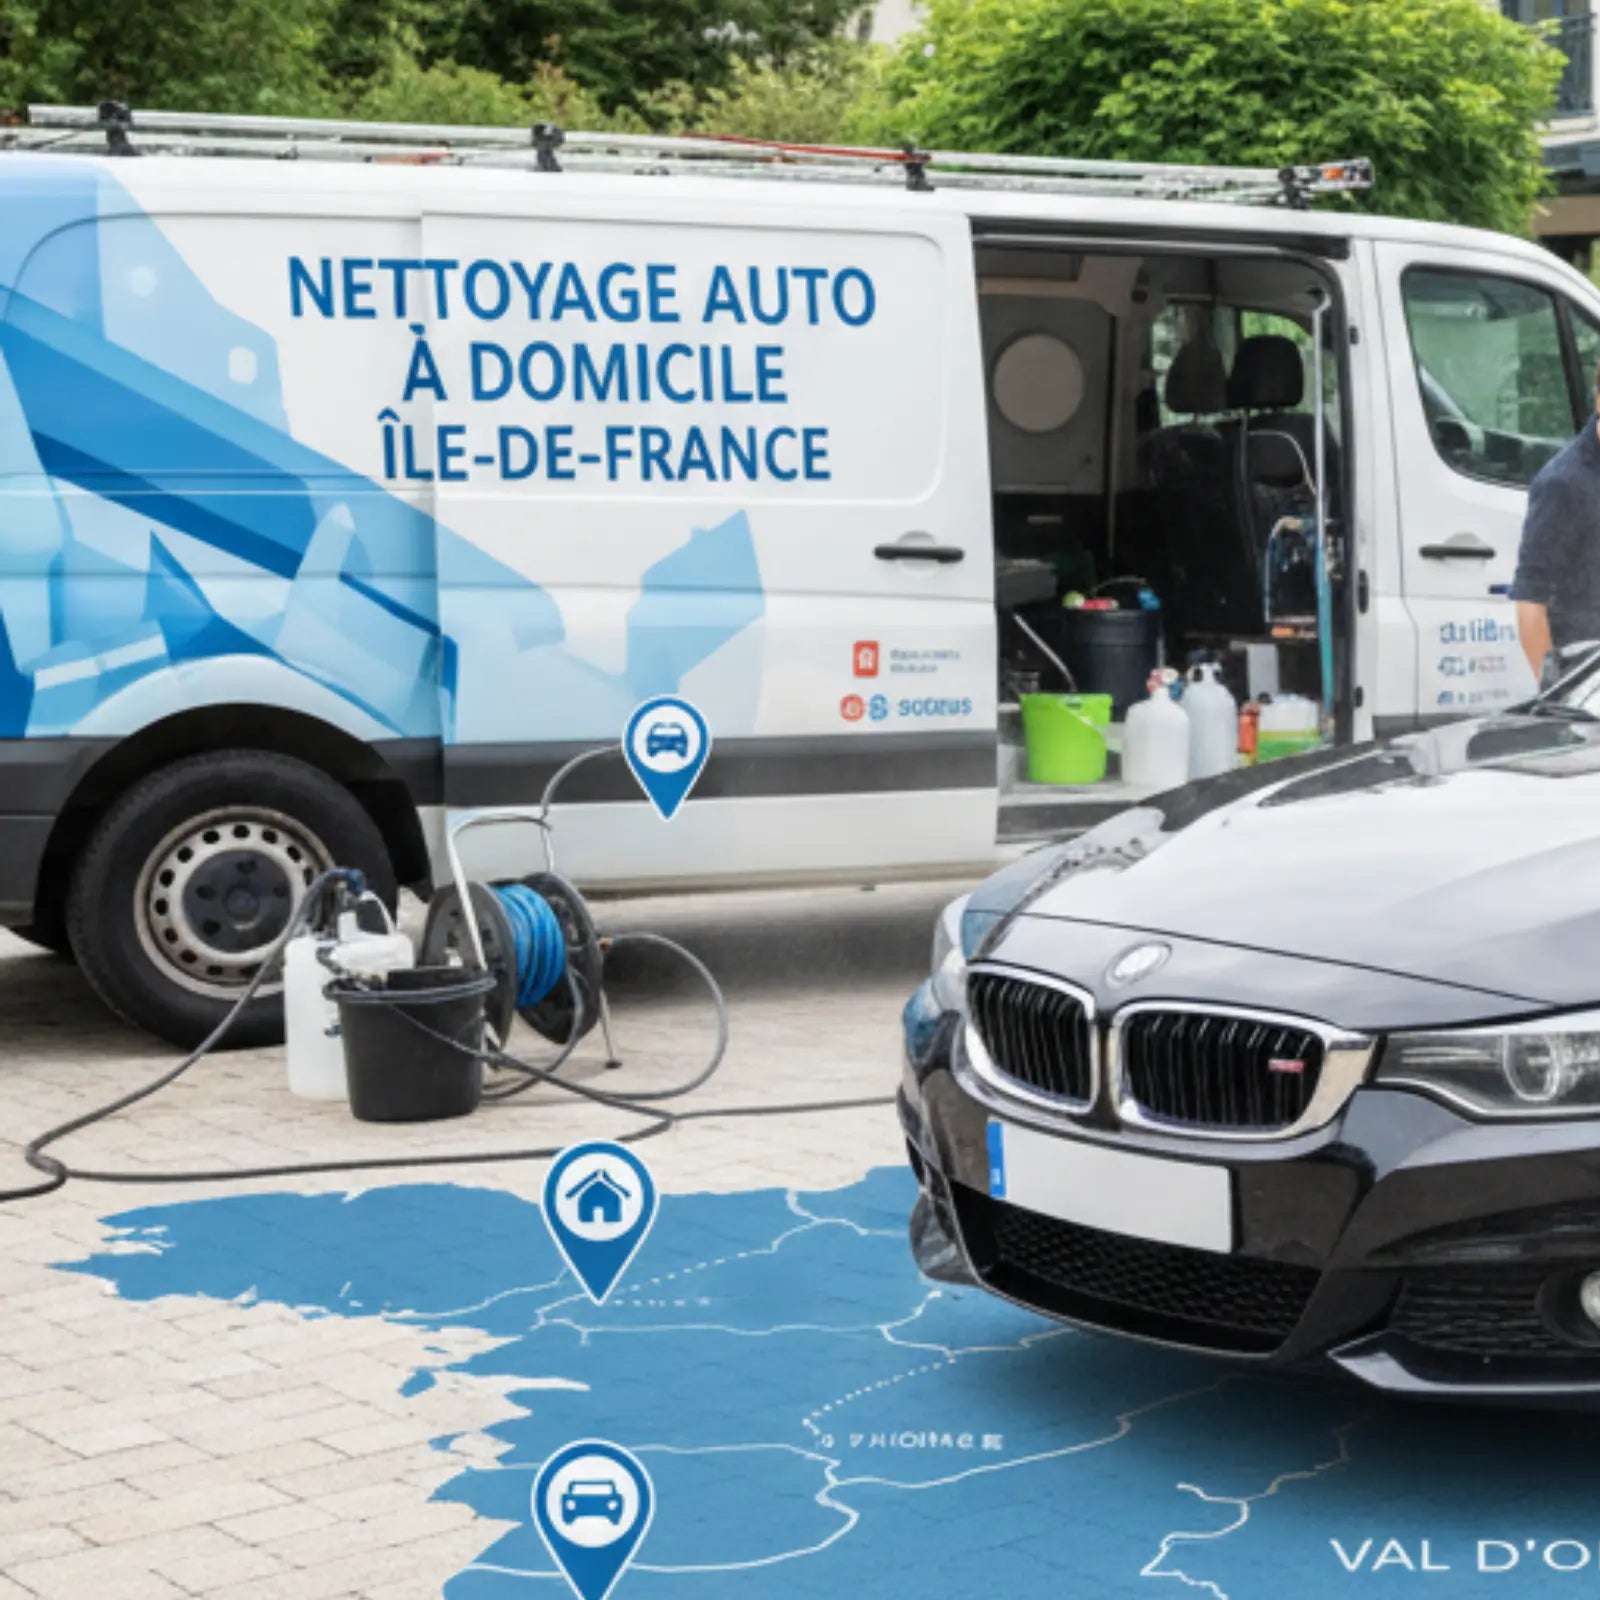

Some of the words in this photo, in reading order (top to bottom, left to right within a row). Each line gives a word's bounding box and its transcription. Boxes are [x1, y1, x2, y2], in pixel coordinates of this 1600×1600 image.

[288, 256, 680, 324] NETTOYAGE
[702, 265, 876, 328] AUTO
[402, 323, 447, 402] À
[470, 342, 787, 404] DOMICILE
[376, 408, 832, 482] ÎLE-DE-FRANCE
